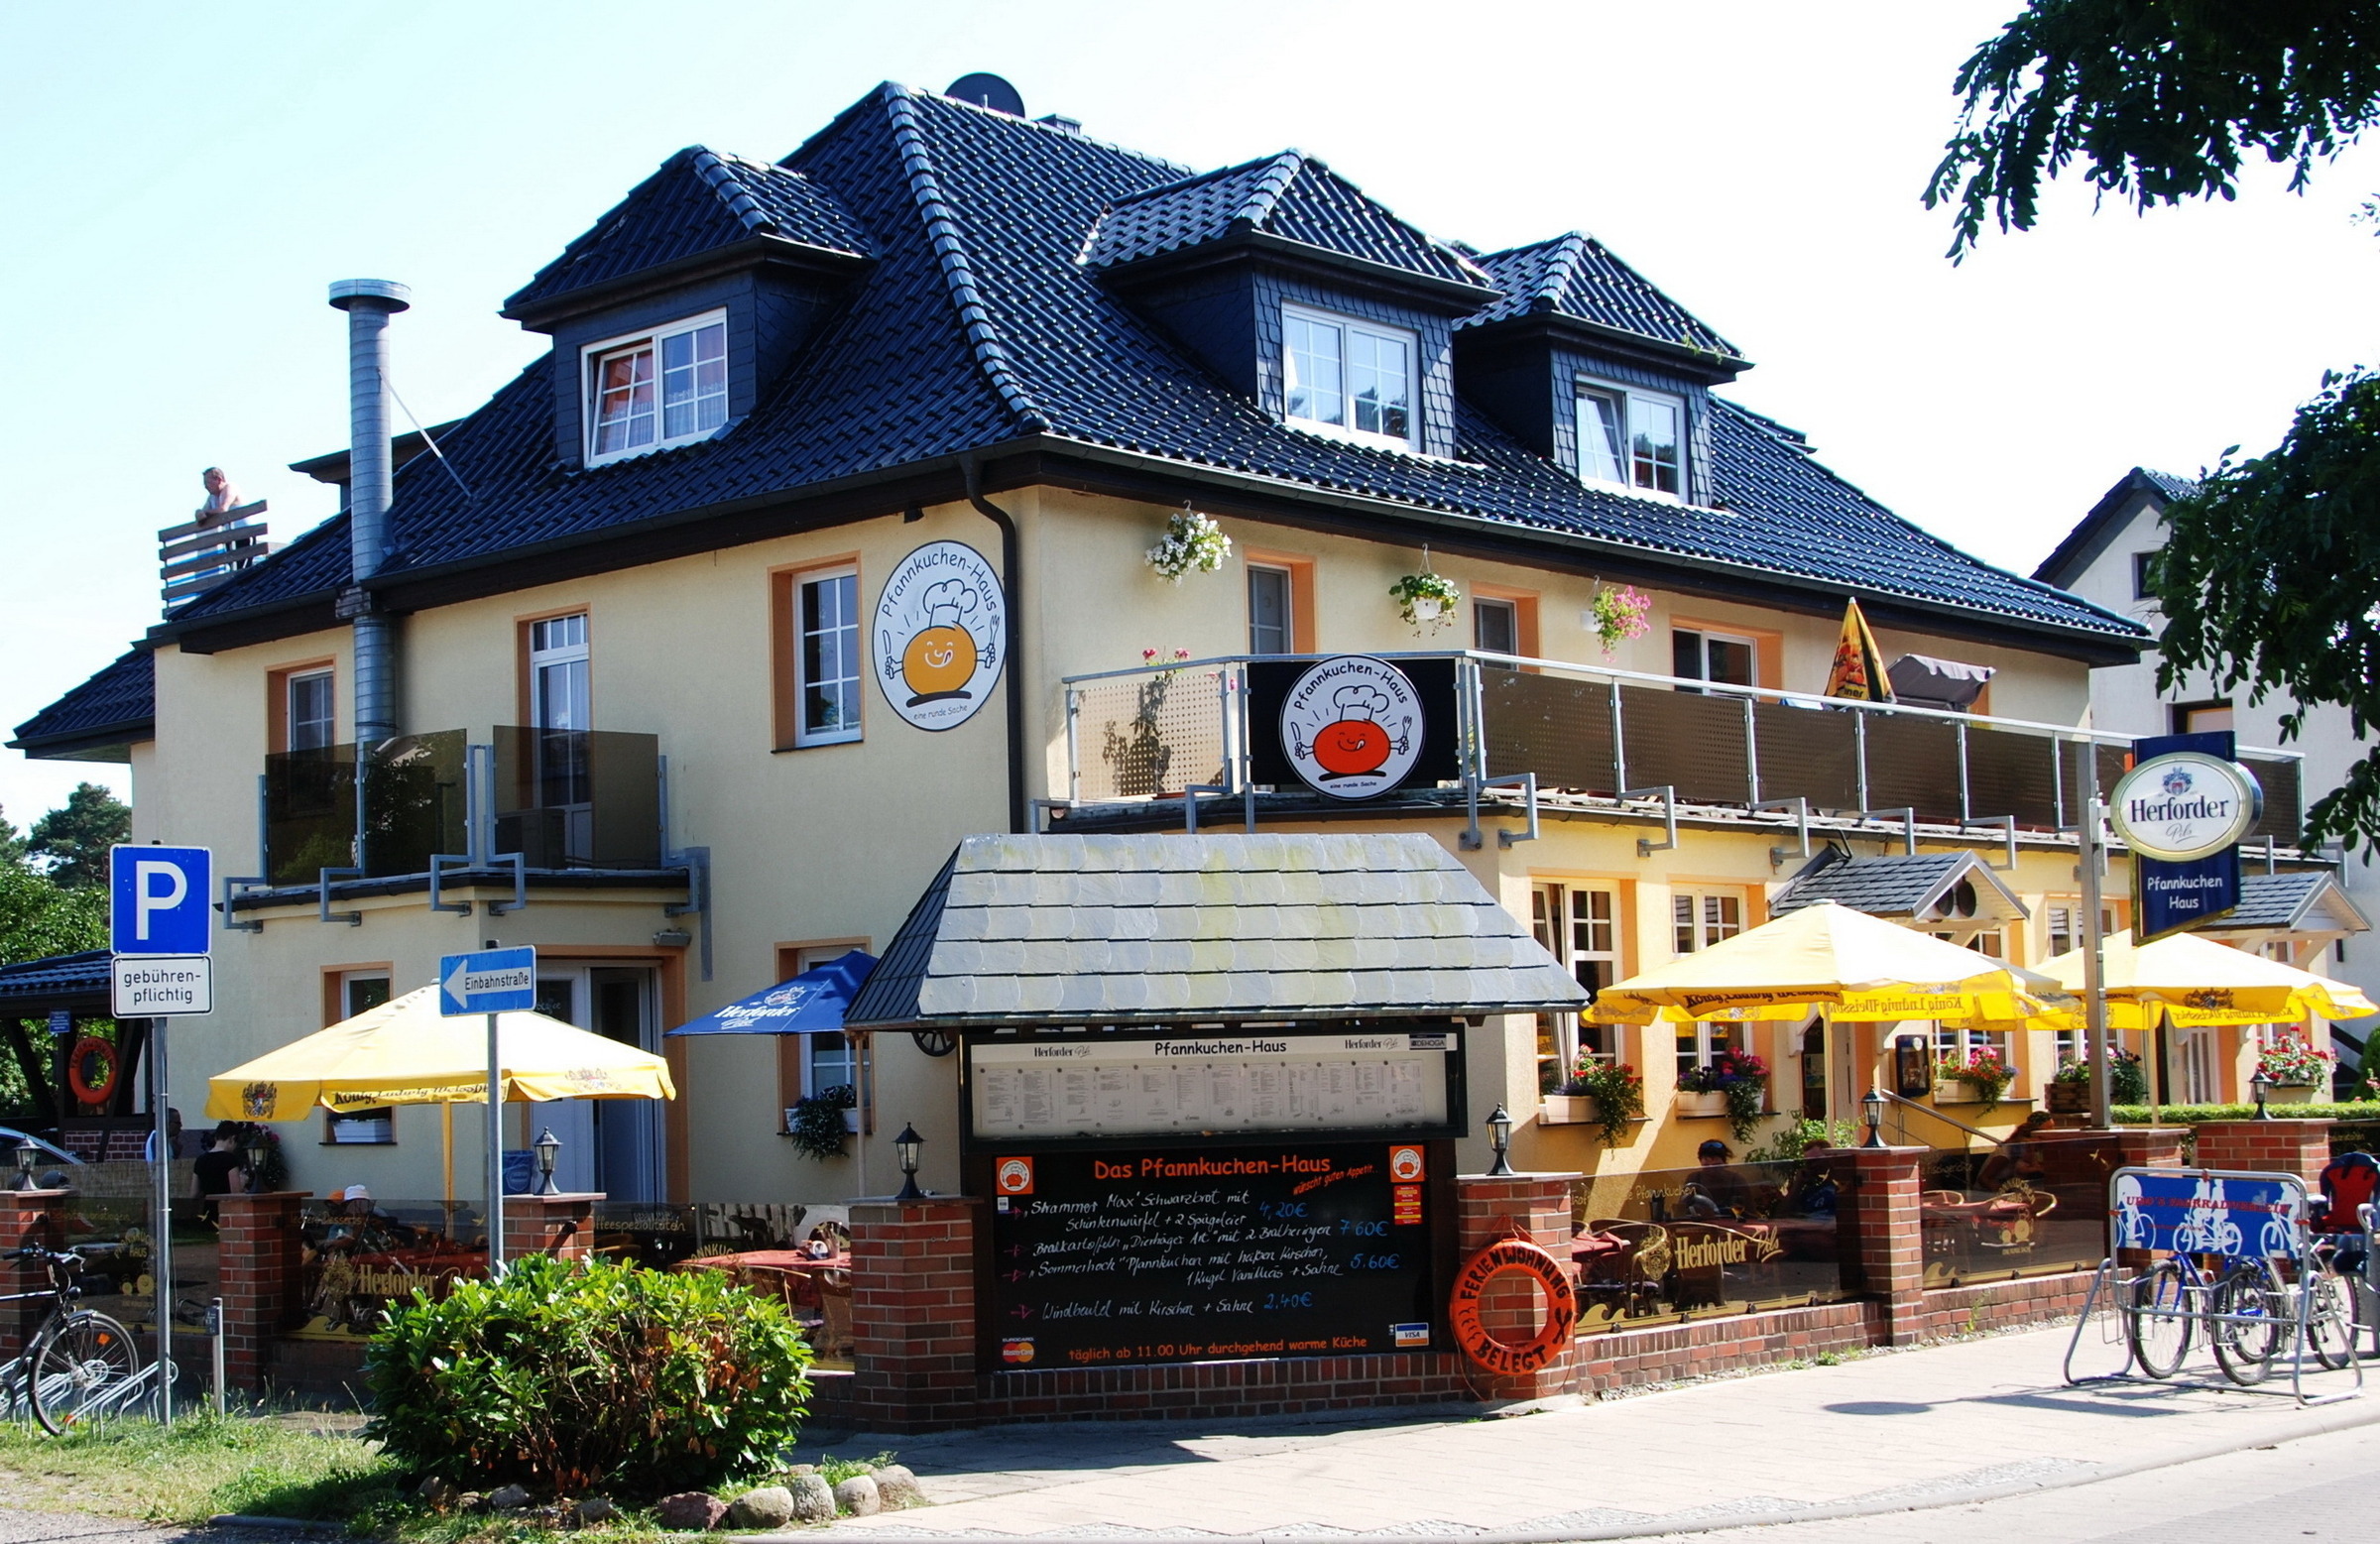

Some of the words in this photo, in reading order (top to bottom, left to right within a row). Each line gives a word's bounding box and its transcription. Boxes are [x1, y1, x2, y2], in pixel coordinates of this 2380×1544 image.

[882, 547, 998, 618] Pfannkuchen-Haus
[1293, 661, 1408, 710] Pfannkuchen-Haus
[913, 710, 927, 720] eine
[928, 707, 947, 719] runde
[948, 704, 968, 716] Sache
[2131, 795, 2229, 823] Herforder
[2166, 823, 2196, 843] Pils
[2147, 875, 2223, 891] Pfannkuchen
[136, 861, 187, 940] P
[2169, 894, 2200, 909] Haus
[124, 969, 201, 988] gebühren-
[465, 971, 530, 991] Einbahnstraße
[134, 988, 193, 1006] pflichtig
[714, 1006, 800, 1018] Herforder
[1034, 1047, 1074, 1057] Herforder
[1154, 1040, 1287, 1056] Pfannkuchen-Haus
[1345, 1039, 1382, 1050] Herforder
[1095, 1160, 1132, 1180] Das
[1141, 1154, 1331, 1178] Pfannkuchen-Haus
[1293, 1177, 1322, 1195] wünscht
[1324, 1170, 1345, 1187] guten
[1635, 1182, 1698, 1199] Pfannkuchen
[1141, 1189, 1220, 1207] Schwarzbrot
[1227, 1190, 1250, 1204] mit
[1066, 1211, 1160, 1233] Schinkenwürfel
[1174, 1214, 1184, 1226] 2
[1032, 1235, 1122, 1258] Bratkartoffeln
[1218, 1230, 1241, 1244] mit
[1245, 1229, 1257, 1241] 2
[1675, 1233, 1748, 1269] Herforder
[1749, 1225, 1784, 1262] Pils
[1126, 1255, 1203, 1277] Pfannkuchen
[1208, 1250, 1232, 1265] mit
[1459, 1246, 1572, 1300] FERIENWOHNUNG
[358, 1263, 435, 1297] Herforder
[1195, 1268, 1227, 1290] Kugel
[1302, 1261, 1345, 1277] Sahne
[1042, 1299, 1112, 1320] Windbeutel
[1119, 1300, 1142, 1316] mit
[1148, 1299, 1196, 1316] Kirschen
[1216, 1299, 1254, 1314] Sahne
[1068, 1348, 1111, 1364] täglich
[1117, 1346, 1131, 1358] ab
[1137, 1344, 1174, 1359] 11.00
[1179, 1343, 1203, 1356] Uhr
[1208, 1339, 1284, 1356] durchgehend
[1289, 1340, 1327, 1351] warme
[1333, 1337, 1368, 1349] Küche
[1475, 1338, 1547, 1373] BELEGT
